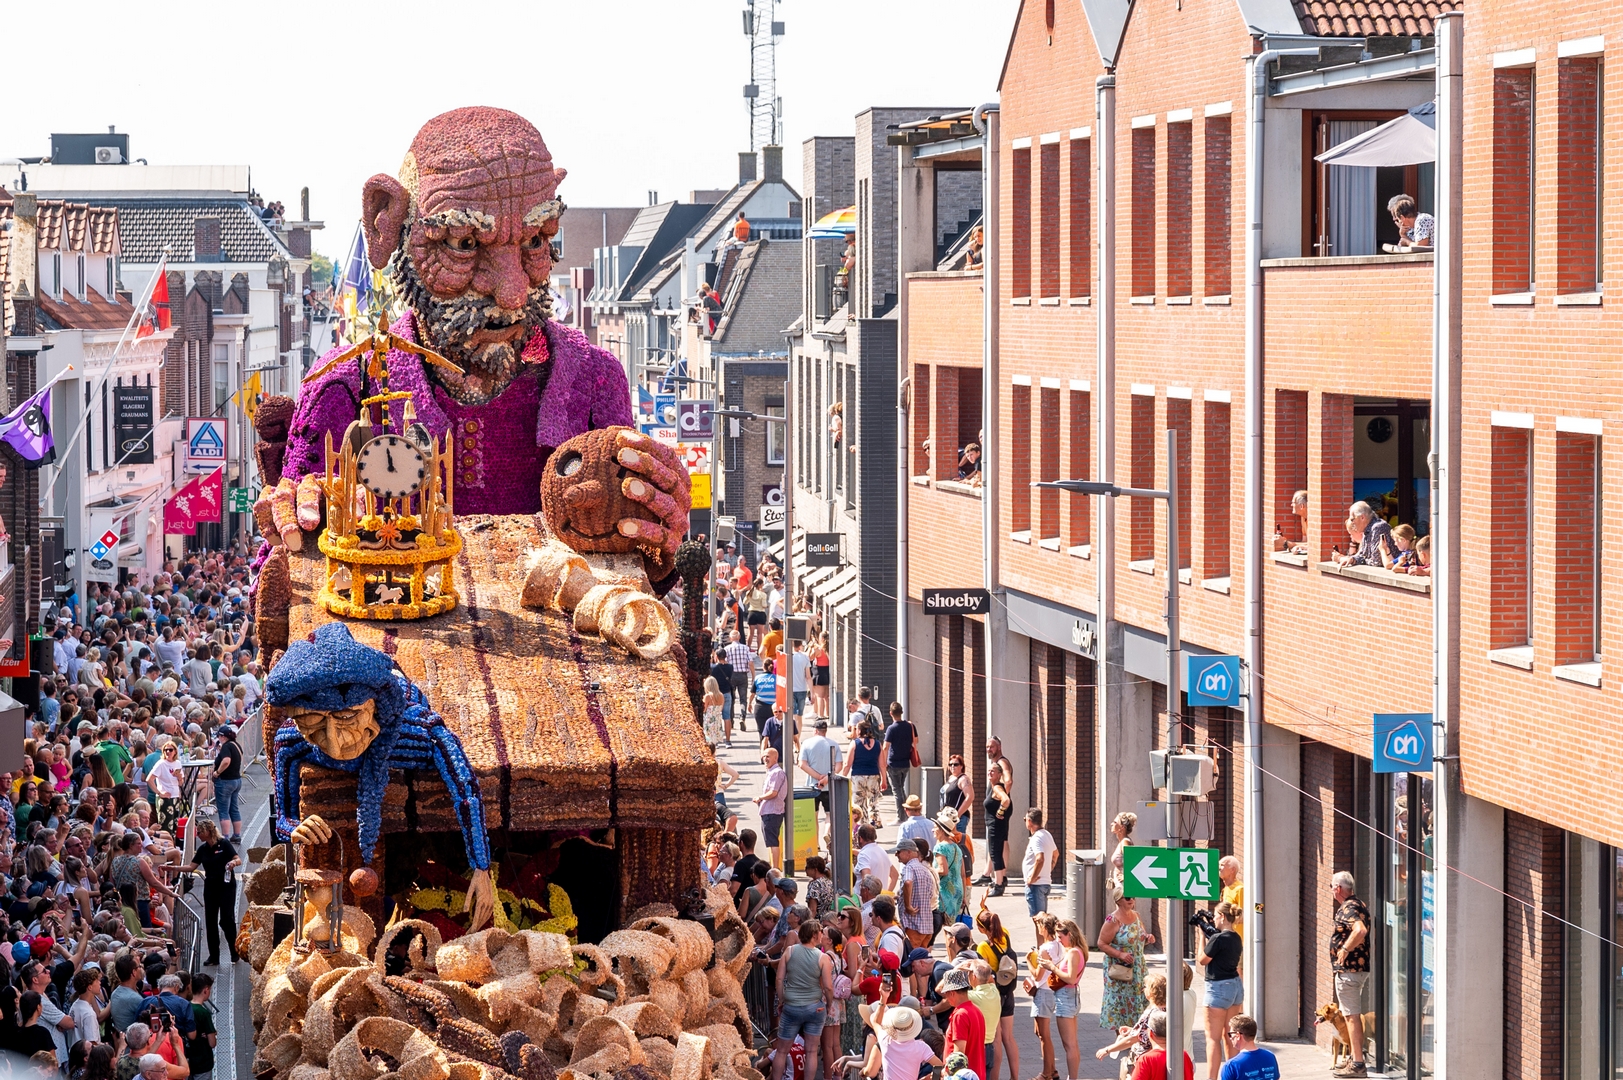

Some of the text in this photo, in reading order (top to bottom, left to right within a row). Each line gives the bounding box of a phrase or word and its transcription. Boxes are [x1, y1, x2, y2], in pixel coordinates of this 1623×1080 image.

[212, 508, 220, 518] U
[166, 520, 194, 530] just U
[926, 592, 983, 610] shoeby
